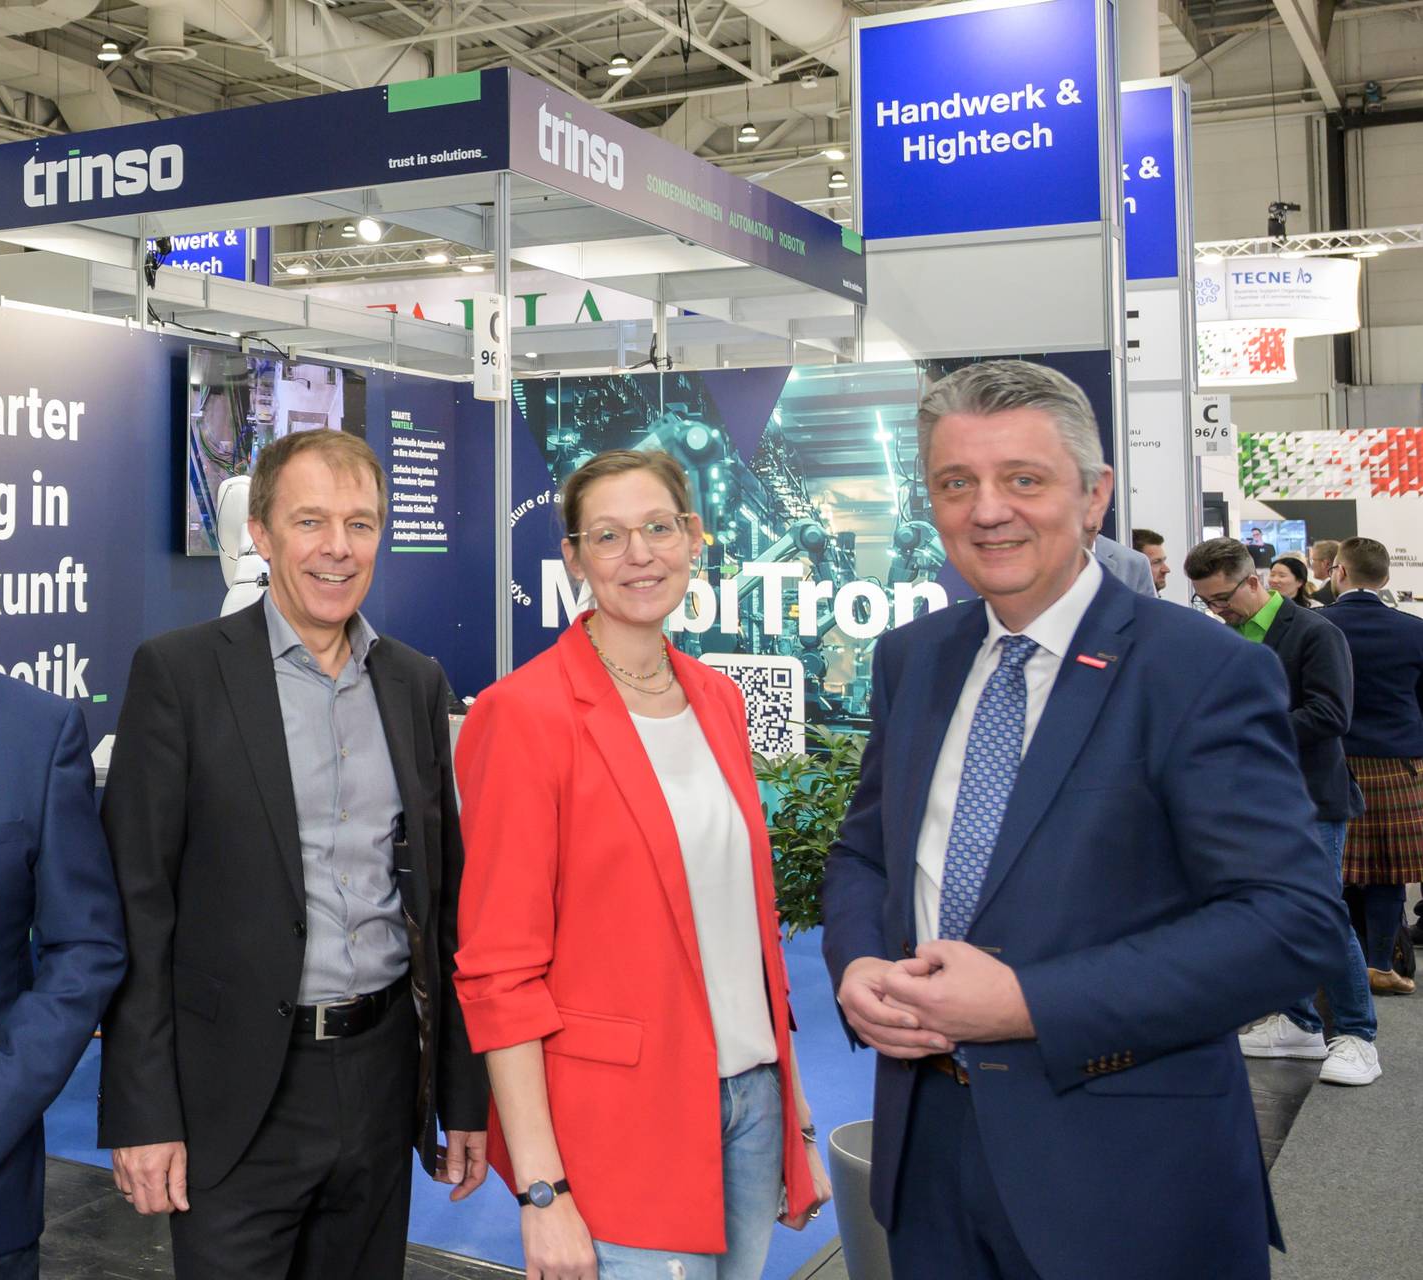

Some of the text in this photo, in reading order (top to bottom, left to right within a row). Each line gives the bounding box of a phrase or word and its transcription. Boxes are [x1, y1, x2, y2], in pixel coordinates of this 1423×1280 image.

[877, 78, 1082, 127] Handwerk &
[388, 155, 415, 169] trust
[417, 153, 428, 165] in
[539, 103, 624, 191] trinso
[903, 122, 1053, 165] Hightech
[23, 143, 184, 208] trinso
[1139, 156, 1161, 179] &
[646, 173, 806, 256] SONDERMASCHINEN AUTOMATION ROBOTIK
[1231, 271, 1291, 284] TECNE
[1202, 404, 1219, 423] C
[1129, 439, 1161, 448] ierung
[32, 469, 69, 527] in
[510, 499, 535, 528] uture
[537, 489, 551, 505] of
[541, 559, 949, 639] MbiTron
